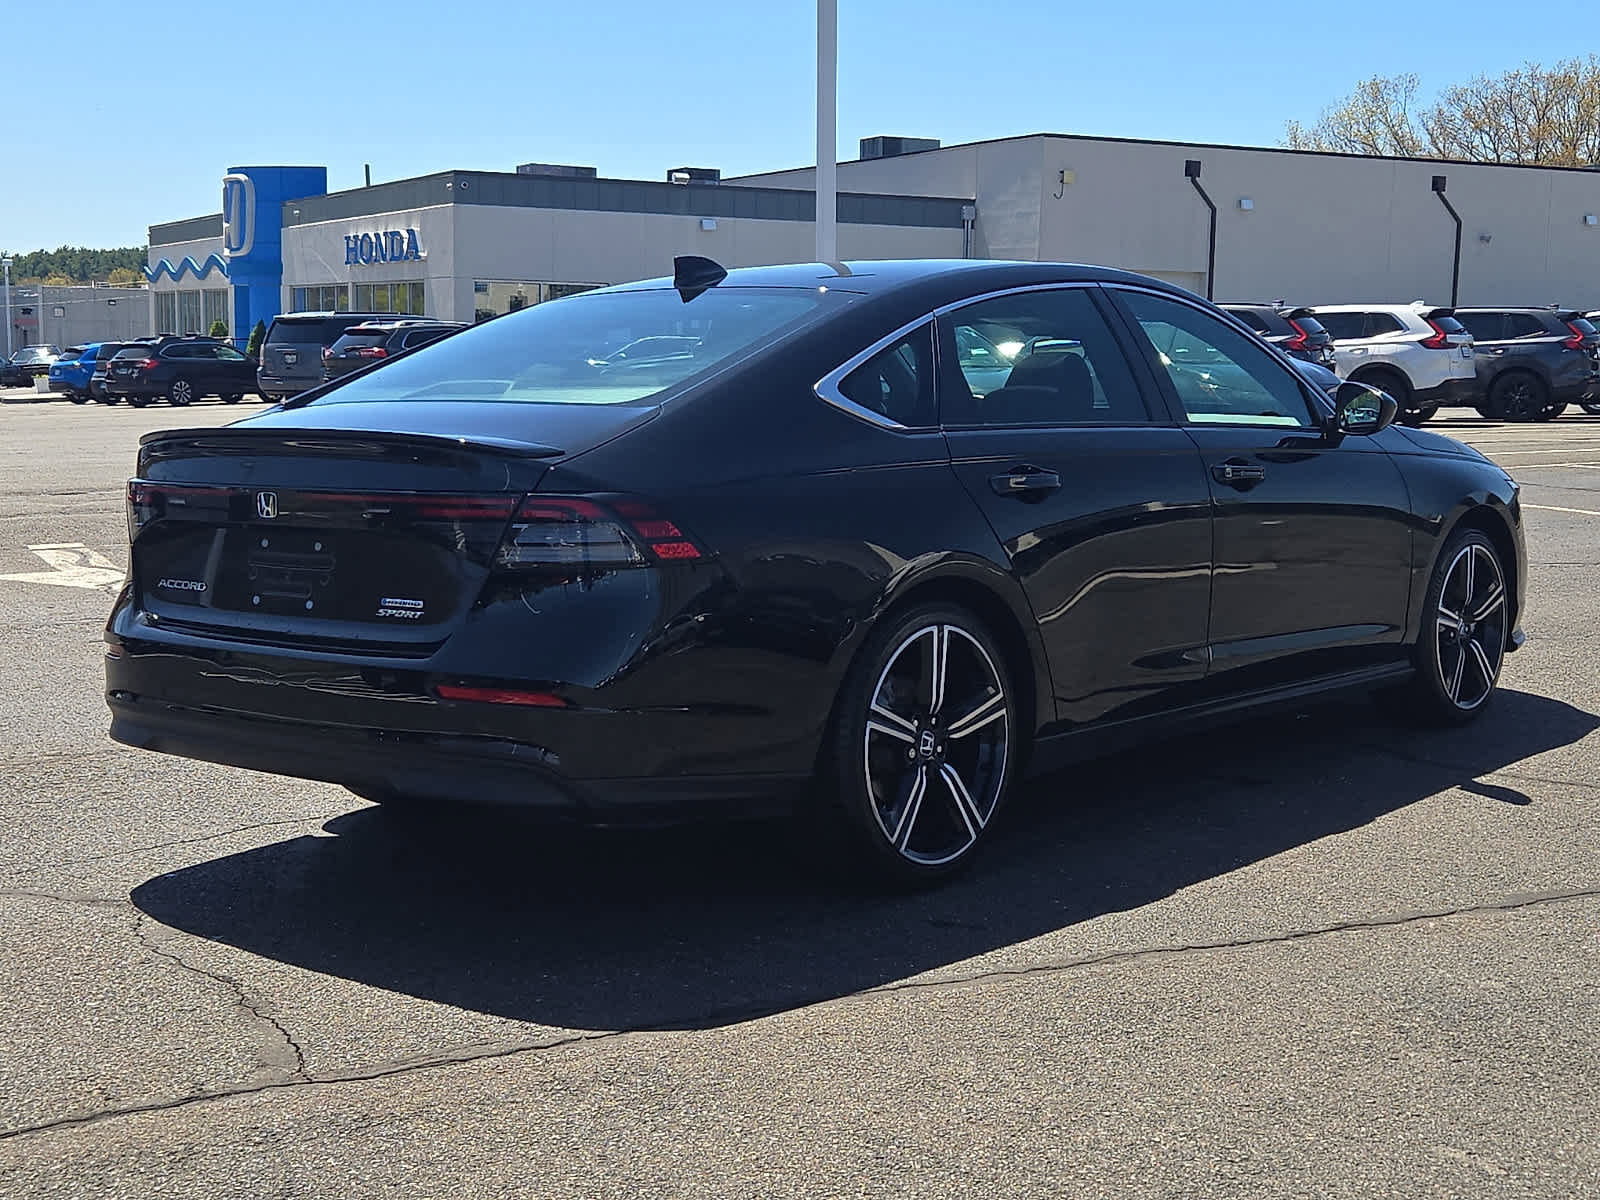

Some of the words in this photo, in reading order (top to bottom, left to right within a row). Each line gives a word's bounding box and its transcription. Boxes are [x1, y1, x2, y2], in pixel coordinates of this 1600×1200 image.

[344, 228, 422, 265] HONDA
[158, 579, 207, 591] ACCORD
[376, 608, 425, 618] SPORT
